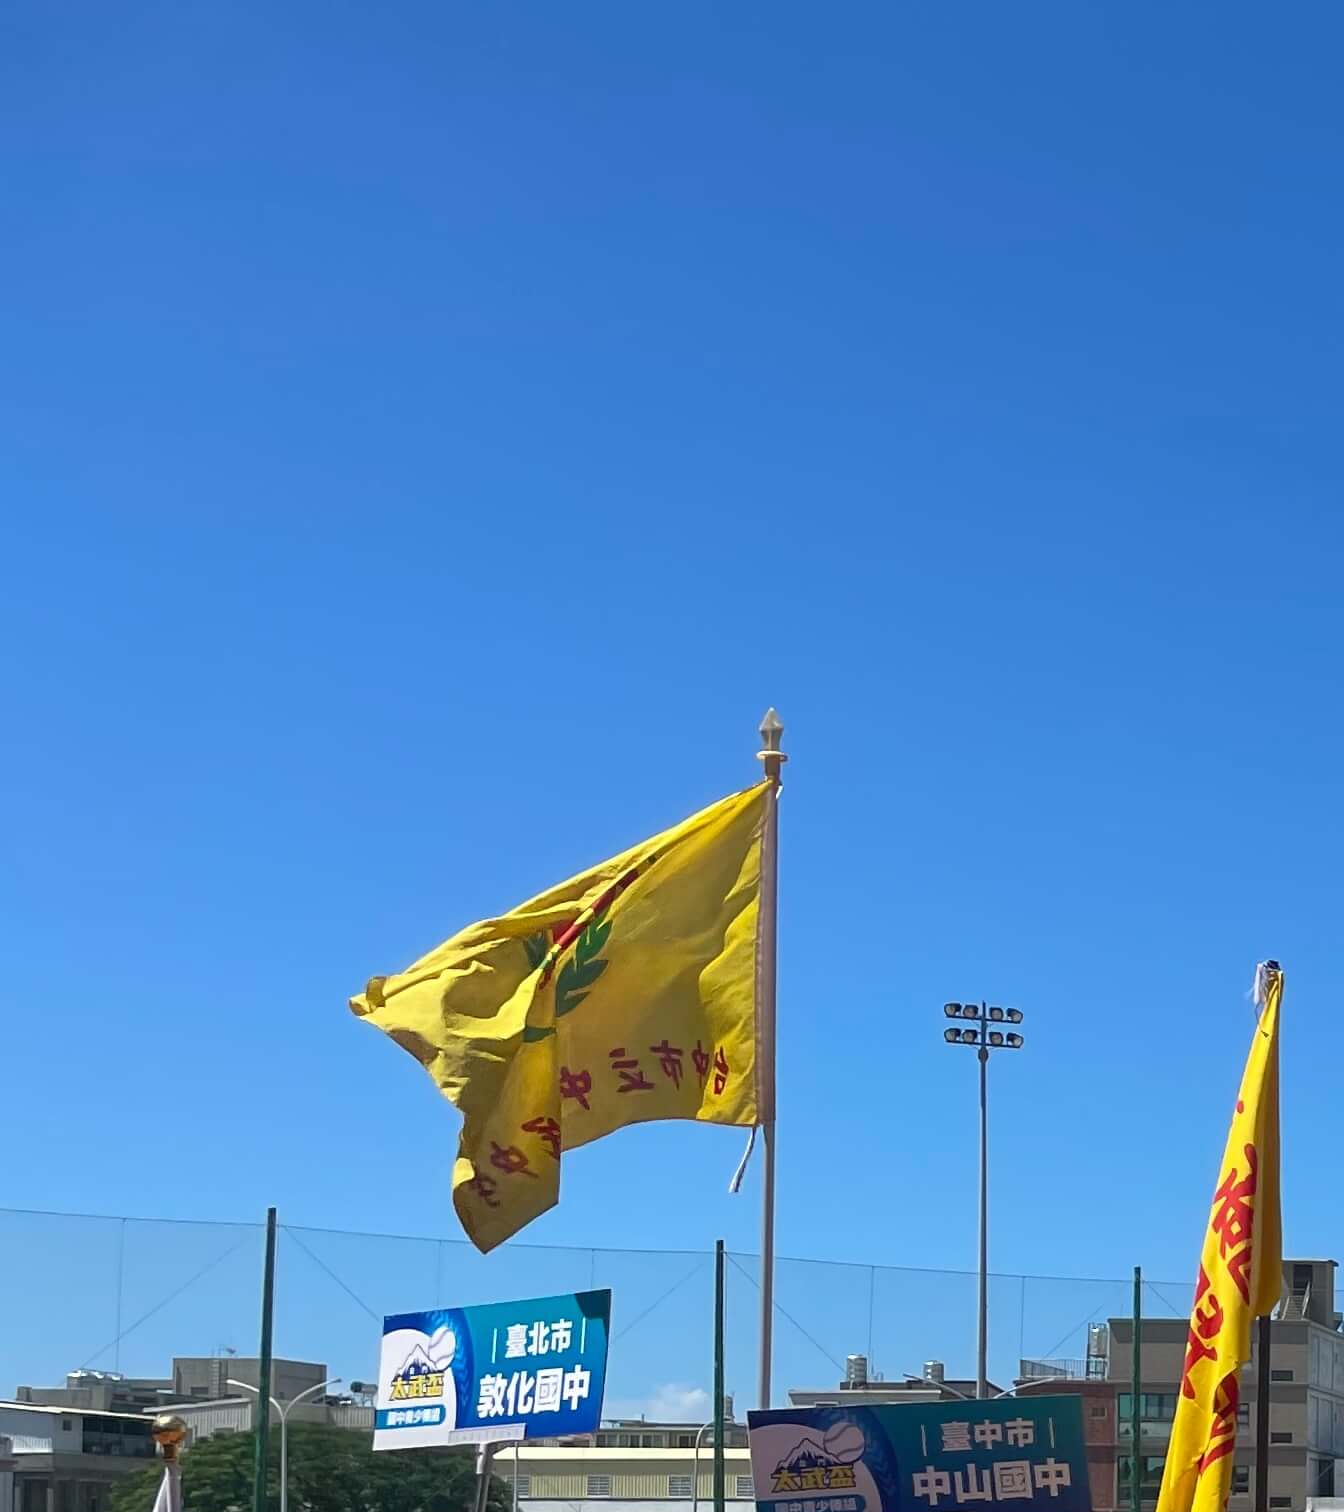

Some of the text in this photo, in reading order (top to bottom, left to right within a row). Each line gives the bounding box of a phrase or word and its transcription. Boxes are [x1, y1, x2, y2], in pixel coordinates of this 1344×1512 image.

[505, 1318, 573, 1359] 臺北市
[388, 1372, 445, 1402] 太武盃
[477, 1364, 591, 1419] 敦化國中
[941, 1417, 1034, 1452] 臺中市
[770, 1464, 857, 1493] 太武盃
[911, 1457, 1073, 1506] 中山國中
